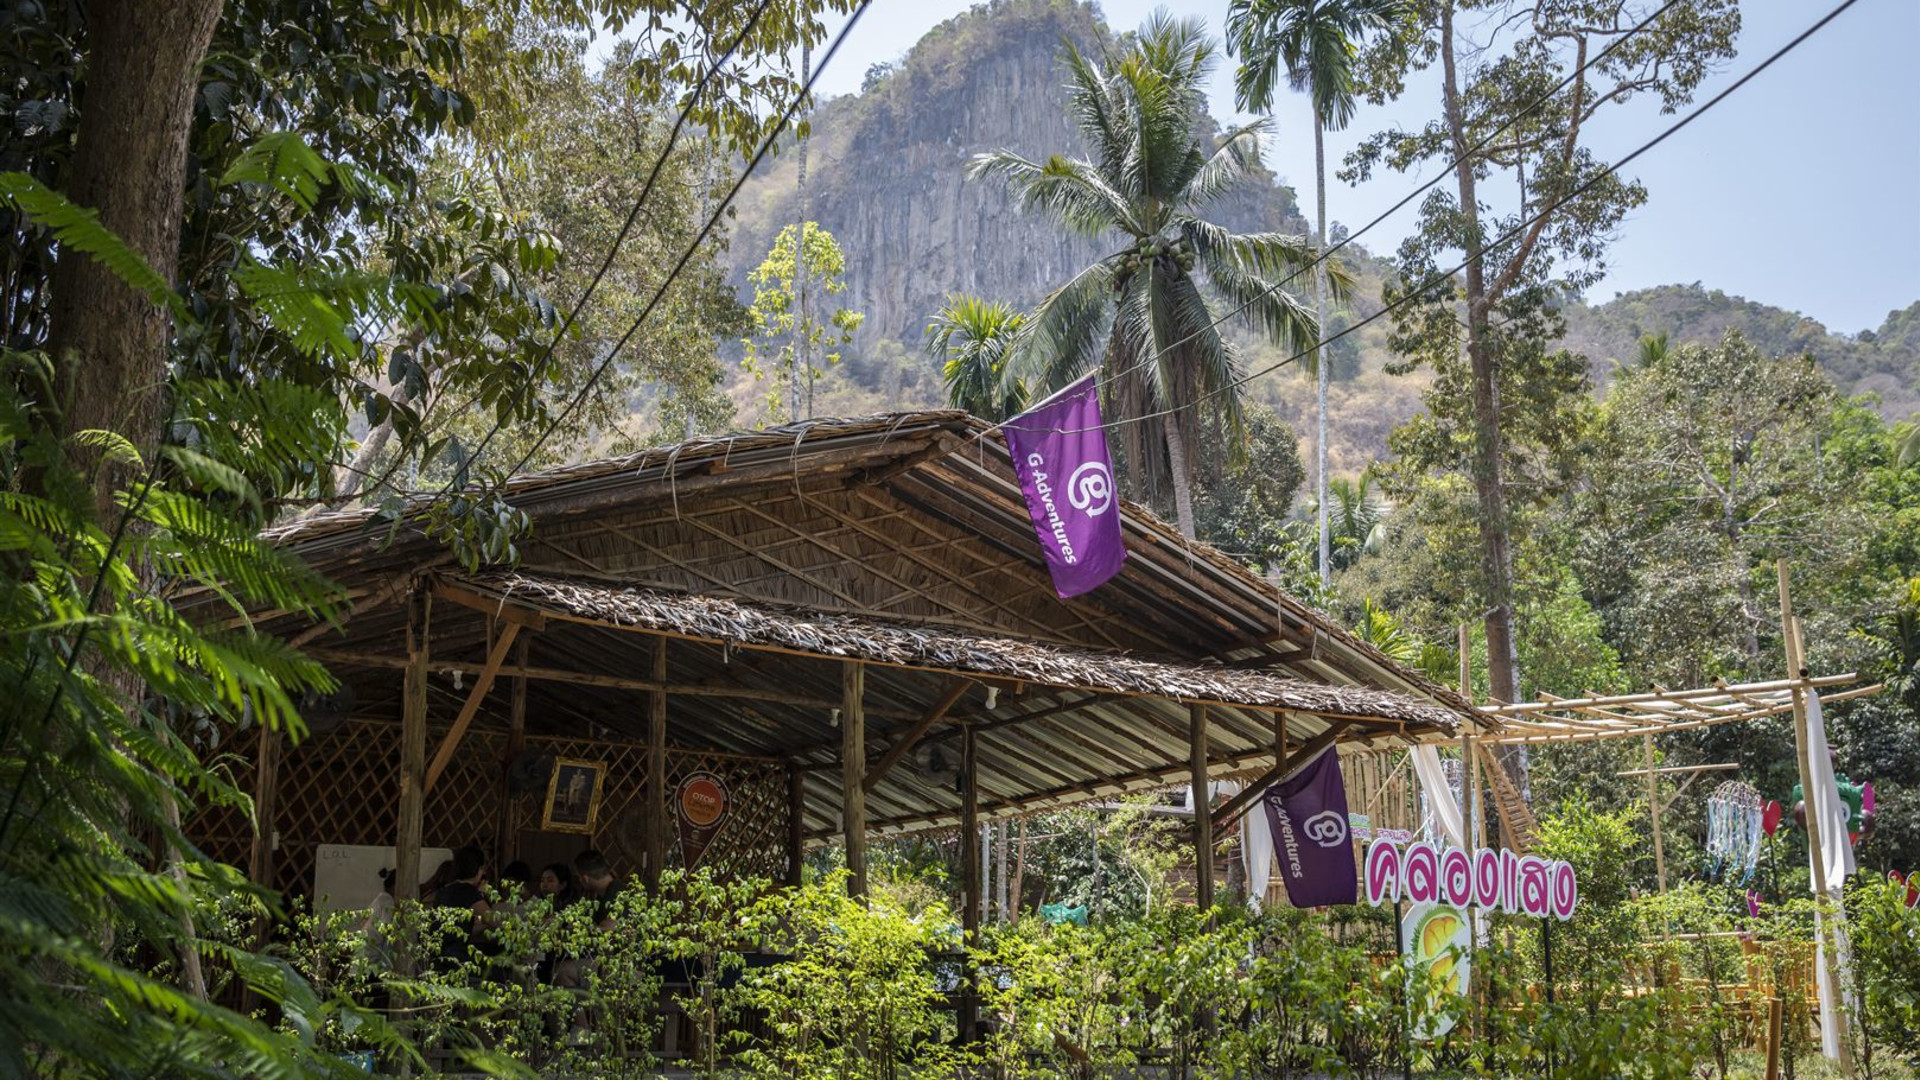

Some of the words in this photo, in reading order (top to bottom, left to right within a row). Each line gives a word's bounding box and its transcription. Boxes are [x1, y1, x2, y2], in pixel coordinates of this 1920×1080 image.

[1028, 453, 1043, 467] G
[1032, 470, 1077, 564] Adventures
[692, 792, 716, 804] OTOP
[1367, 838, 1577, 921] คลองแสง
